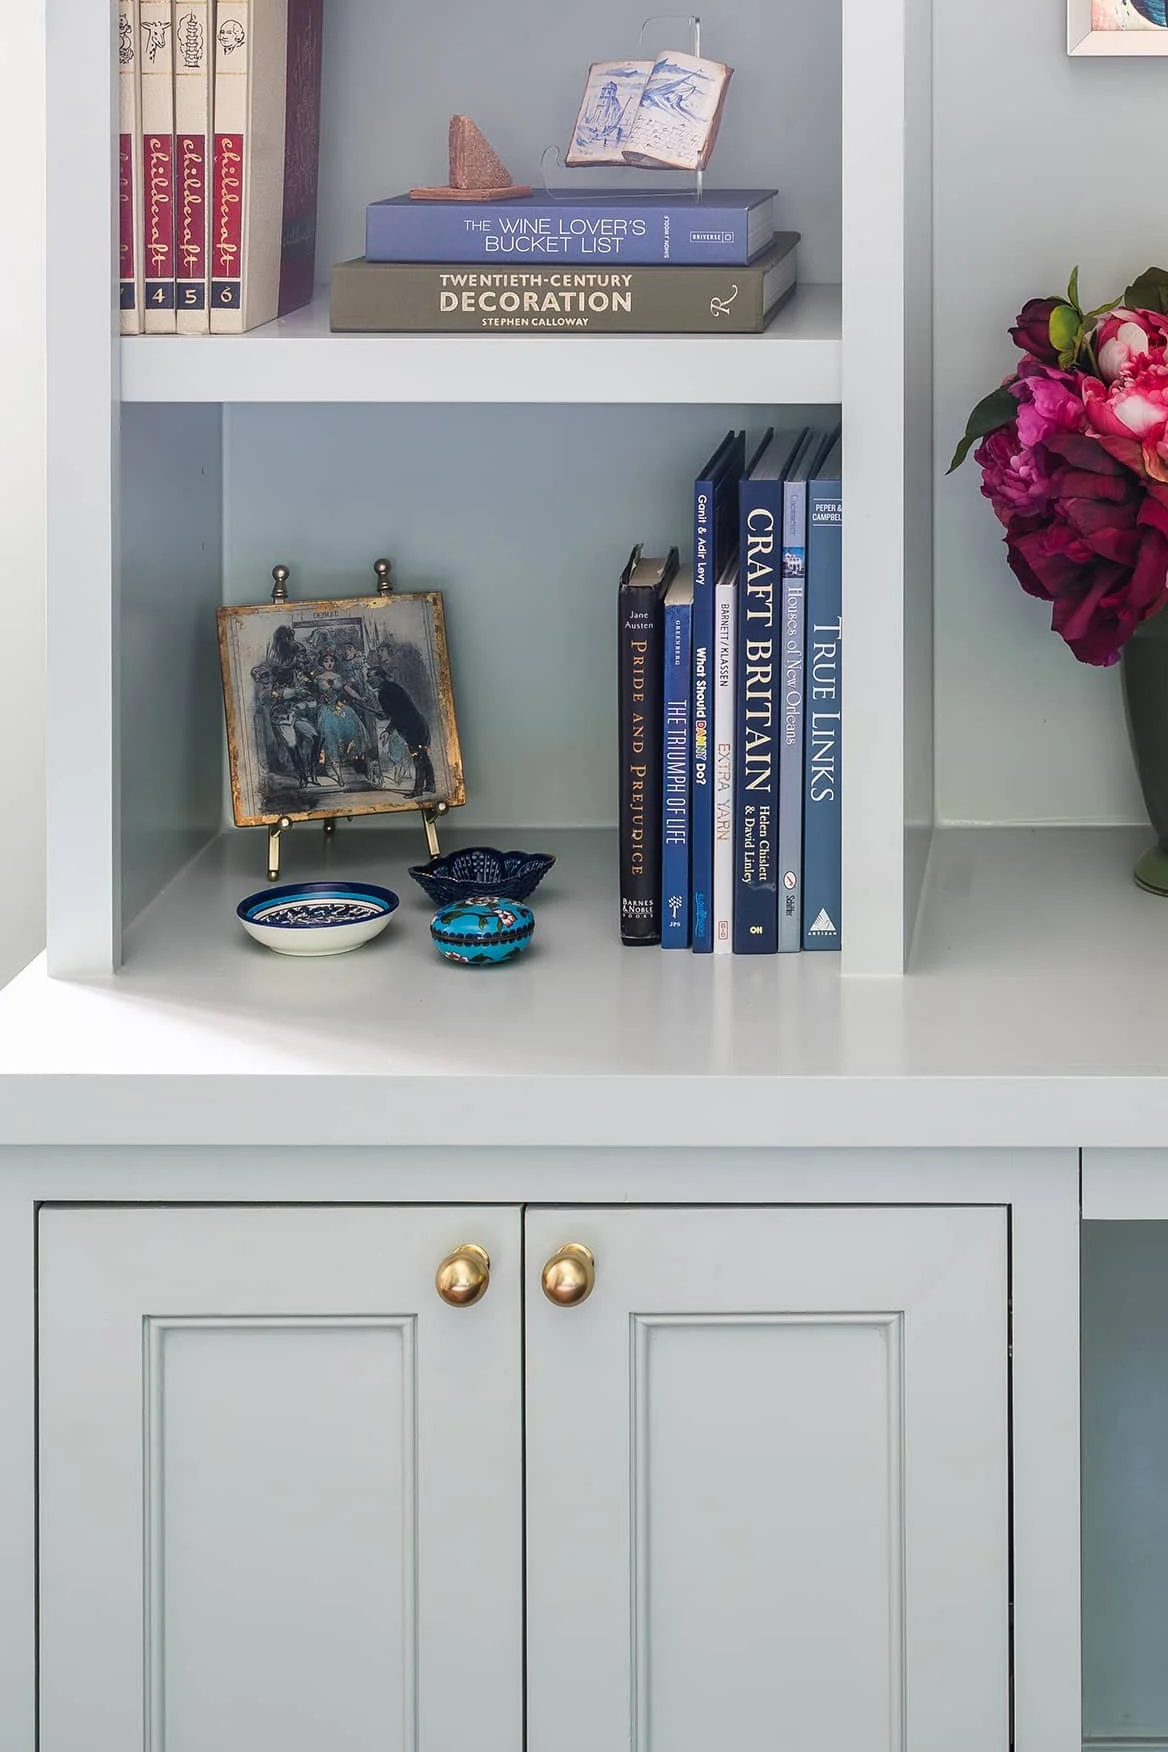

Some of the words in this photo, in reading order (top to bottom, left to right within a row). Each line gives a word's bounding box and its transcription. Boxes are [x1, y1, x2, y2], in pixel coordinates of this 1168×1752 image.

[147, 138, 169, 276] childcraft
[180, 139, 202, 277] childcraft
[216, 137, 240, 276] childcraft
[463, 219, 492, 232] THE
[499, 218, 551, 234] WINE
[559, 219, 646, 236] LOVER'S
[485, 235, 573, 253] BUCKET
[581, 237, 624, 253] LIST
[220, 286, 232, 303] 6
[439, 274, 633, 287] TWENTIETH-CENTURY
[151, 288, 166, 303] 4
[184, 289, 197, 304] 5
[440, 291, 632, 312] DECORATION
[481, 317, 529, 327] STEPHEN
[531, 317, 589, 327] CALLOWAY
[697, 494, 708, 523] Ganit
[815, 503, 836, 512] PEPER
[697, 526, 707, 534] &
[697, 537, 708, 559] Adir
[695, 562, 707, 585] Levy
[747, 508, 774, 627] CRAFT
[624, 621, 654, 629] Austen
[630, 610, 649, 619] Jane
[787, 587, 803, 636] Houses
[696, 647, 707, 677] What
[787, 640, 802, 655] of
[812, 615, 842, 700] TRUE
[631, 639, 648, 702] PRIDE
[786, 659, 802, 688] New
[667, 700, 687, 725] THE
[696, 680, 707, 718] Should
[745, 639, 772, 793] BRITAIN
[785, 690, 802, 745] Orleans
[631, 712, 644, 753] AND
[695, 720, 707, 761] DANNY
[667, 729, 687, 792] TRIUMPH
[718, 743, 731, 791] EXTRA
[811, 711, 840, 802] LINKS
[696, 763, 707, 785] Do?
[630, 765, 647, 875] PREJUDICE
[666, 798, 686, 815] OF
[717, 800, 731, 841] YARN
[745, 805, 755, 815] &
[759, 805, 770, 837] Helen
[666, 818, 686, 845] LIFE
[744, 818, 755, 849] David
[742, 852, 755, 883] Linley
[759, 840, 770, 881] Chislett
[622, 897, 654, 906] BARNES
